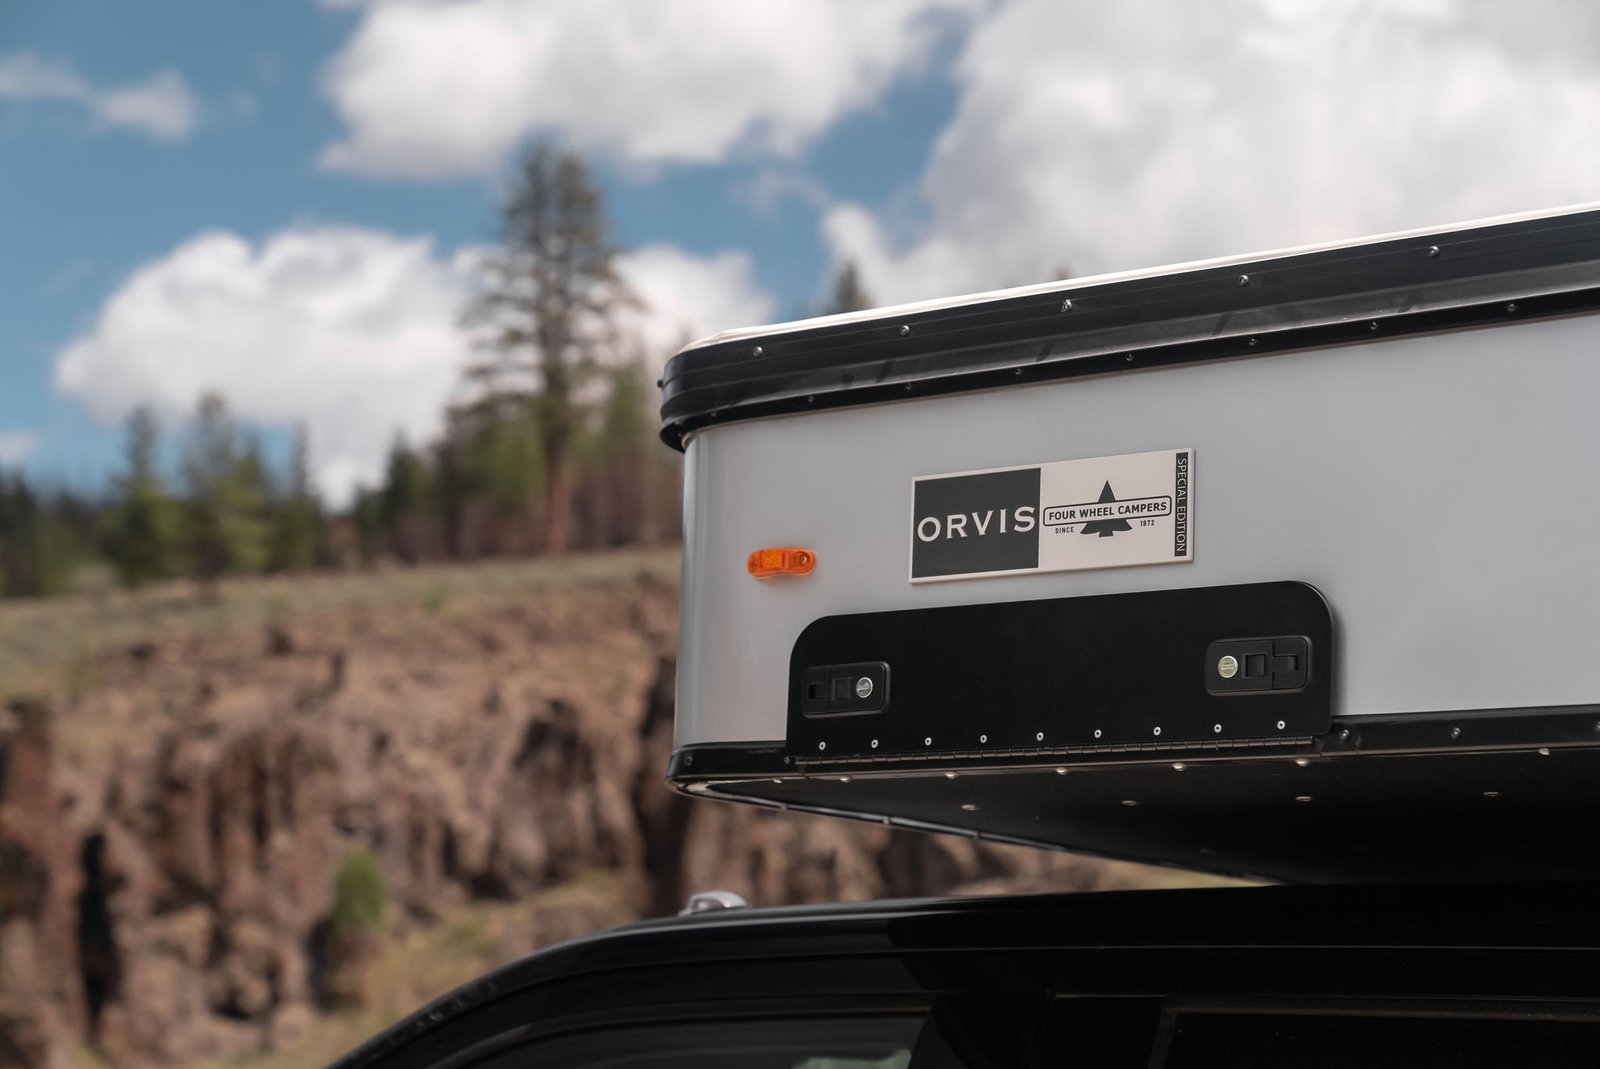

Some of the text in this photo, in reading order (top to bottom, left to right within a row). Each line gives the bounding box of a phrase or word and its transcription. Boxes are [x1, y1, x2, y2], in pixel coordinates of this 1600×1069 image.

[1048, 501, 1168, 521] FOUR WHEEL CAMPERS
[1176, 458, 1187, 552] SPECIAL EDITION
[917, 506, 1036, 542] ORVIS
[1054, 519, 1156, 535] SINCE 1972
